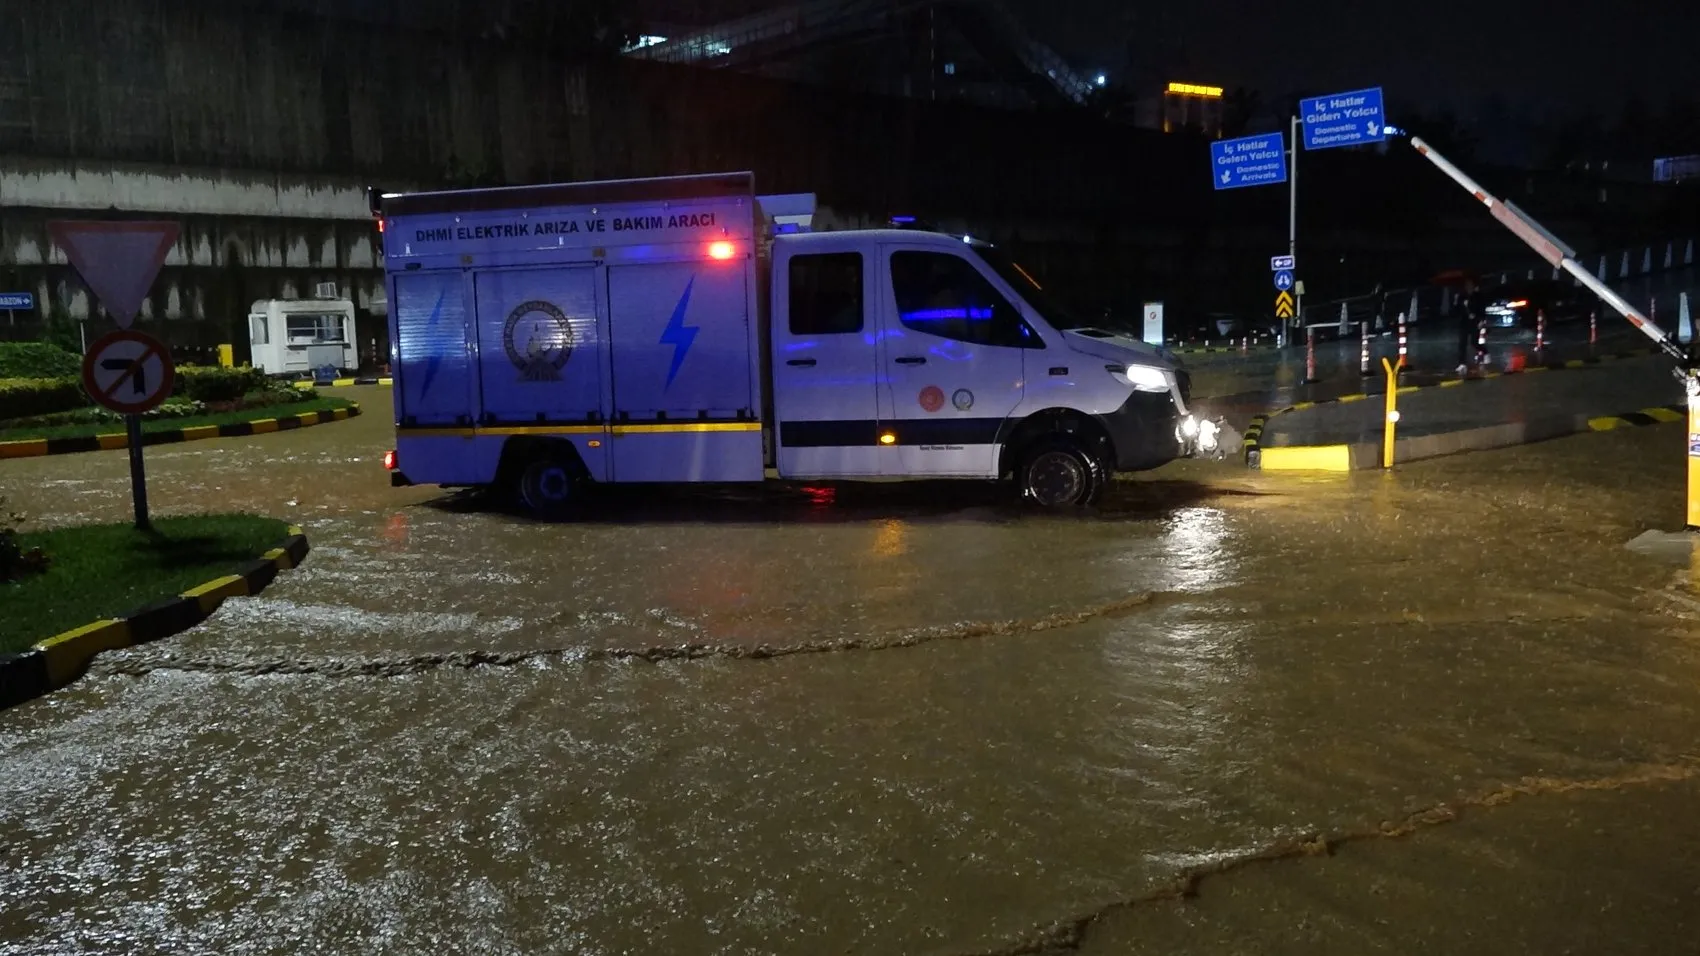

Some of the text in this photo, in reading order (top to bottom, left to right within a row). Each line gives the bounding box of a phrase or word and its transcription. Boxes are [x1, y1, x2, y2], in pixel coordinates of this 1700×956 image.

[1315, 97, 1366, 112] İç Hatlar
[1307, 107, 1378, 123] Giden Yolcu
[1314, 124, 1357, 135] Domestic
[1312, 133, 1361, 144] Departures
[1237, 141, 1269, 151] Hatlar
[1218, 150, 1278, 164] Gelen Yolcu
[1237, 163, 1280, 174] Domestic
[1241, 172, 1277, 181] Arrivals
[457, 222, 529, 240] ELEKTRİK
[534, 221, 579, 236] ARIZA
[585, 219, 605, 233] VE
[613, 216, 663, 231] BAKIM
[668, 213, 715, 228] ARACI
